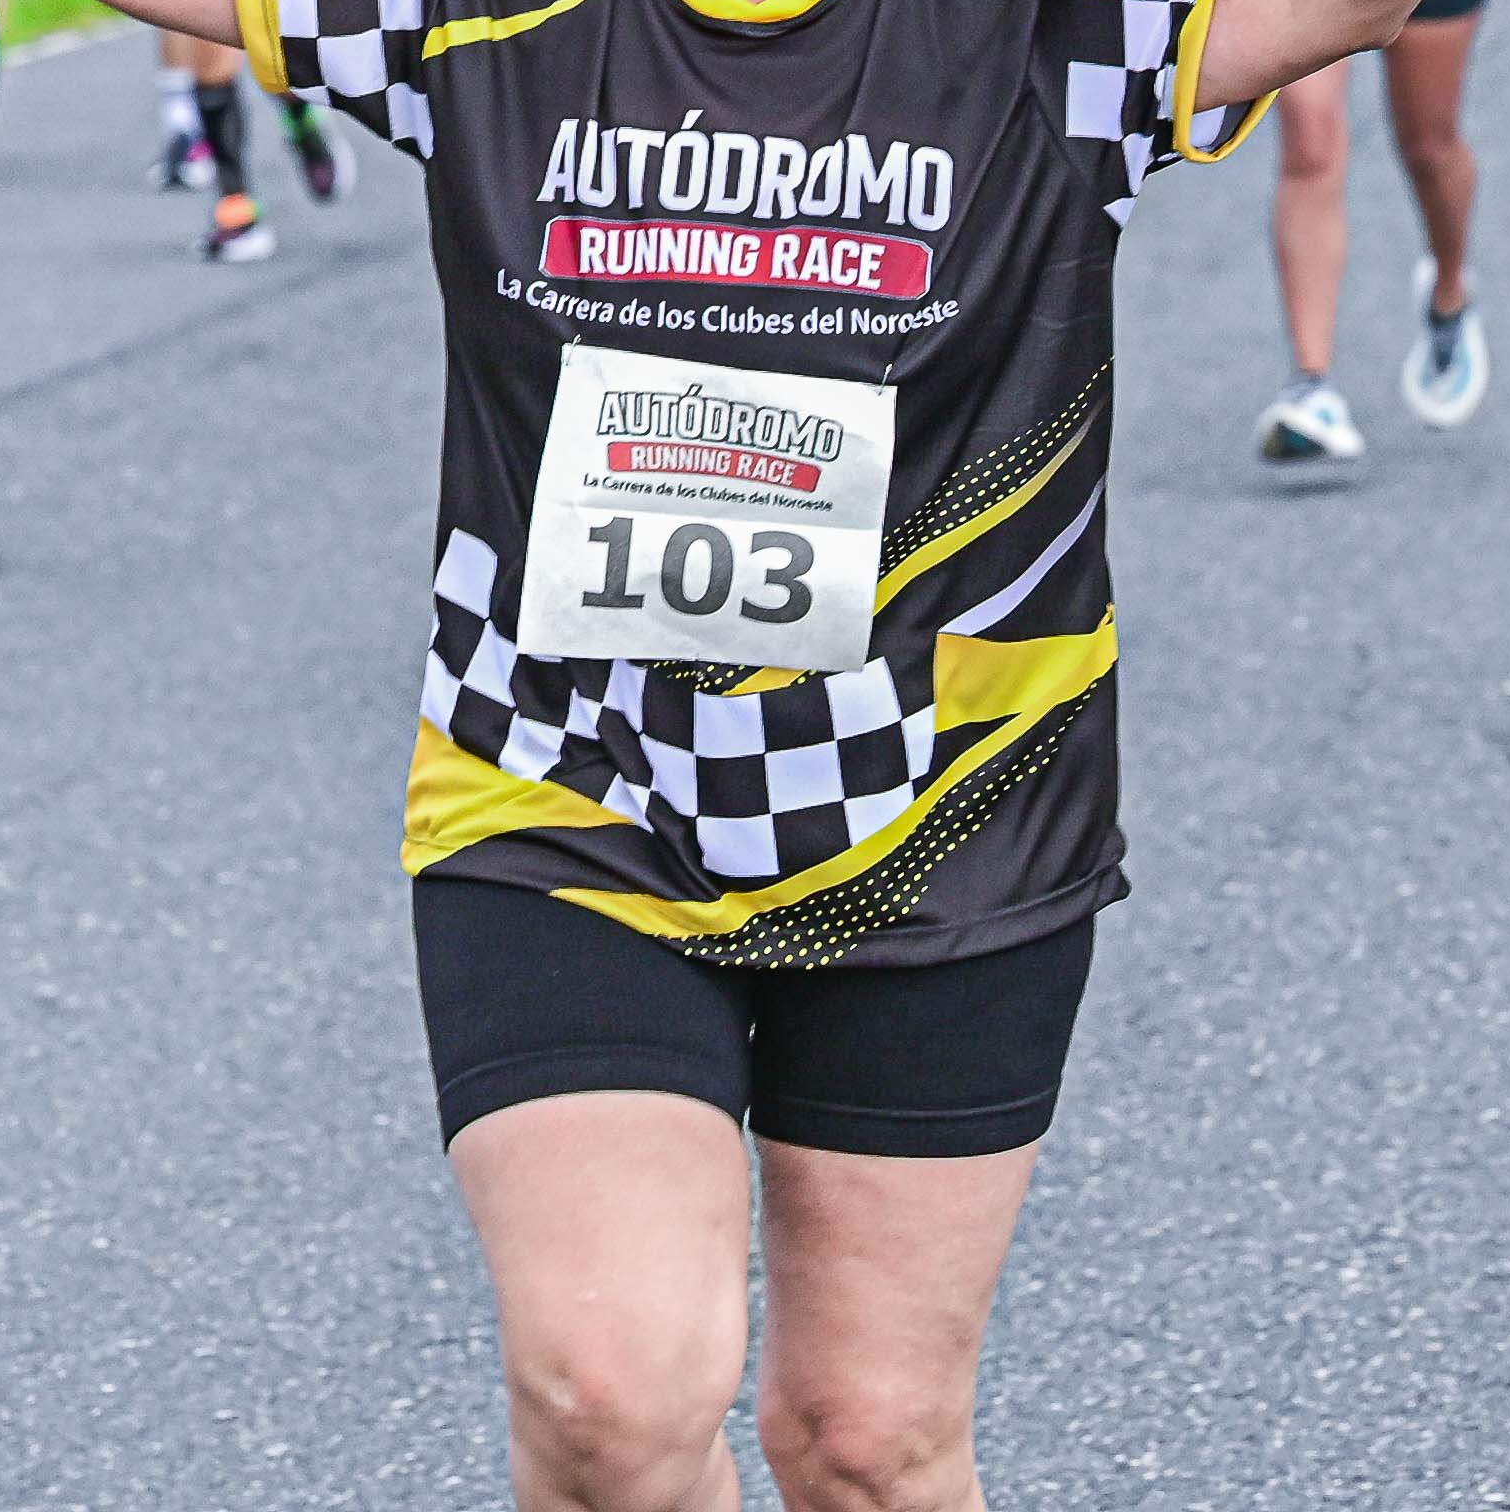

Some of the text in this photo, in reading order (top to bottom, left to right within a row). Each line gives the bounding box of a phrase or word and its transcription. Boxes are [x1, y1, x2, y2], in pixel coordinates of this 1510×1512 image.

[536, 109, 954, 232] AUTÓDROMO
[578, 227, 886, 291] RUNNING RACE
[497, 268, 522, 301] La
[525, 280, 615, 324] Carrera
[618, 297, 652, 327] de
[656, 300, 696, 331] los
[701, 304, 795, 335] Clubes
[800, 306, 843, 335] del
[596, 383, 844, 463] AUTÓDROMO
[583, 472, 835, 514] La Carrera de los Clubes del Noroeste
[630, 445, 799, 487] RUNNING RACE
[581, 515, 815, 625] 103
